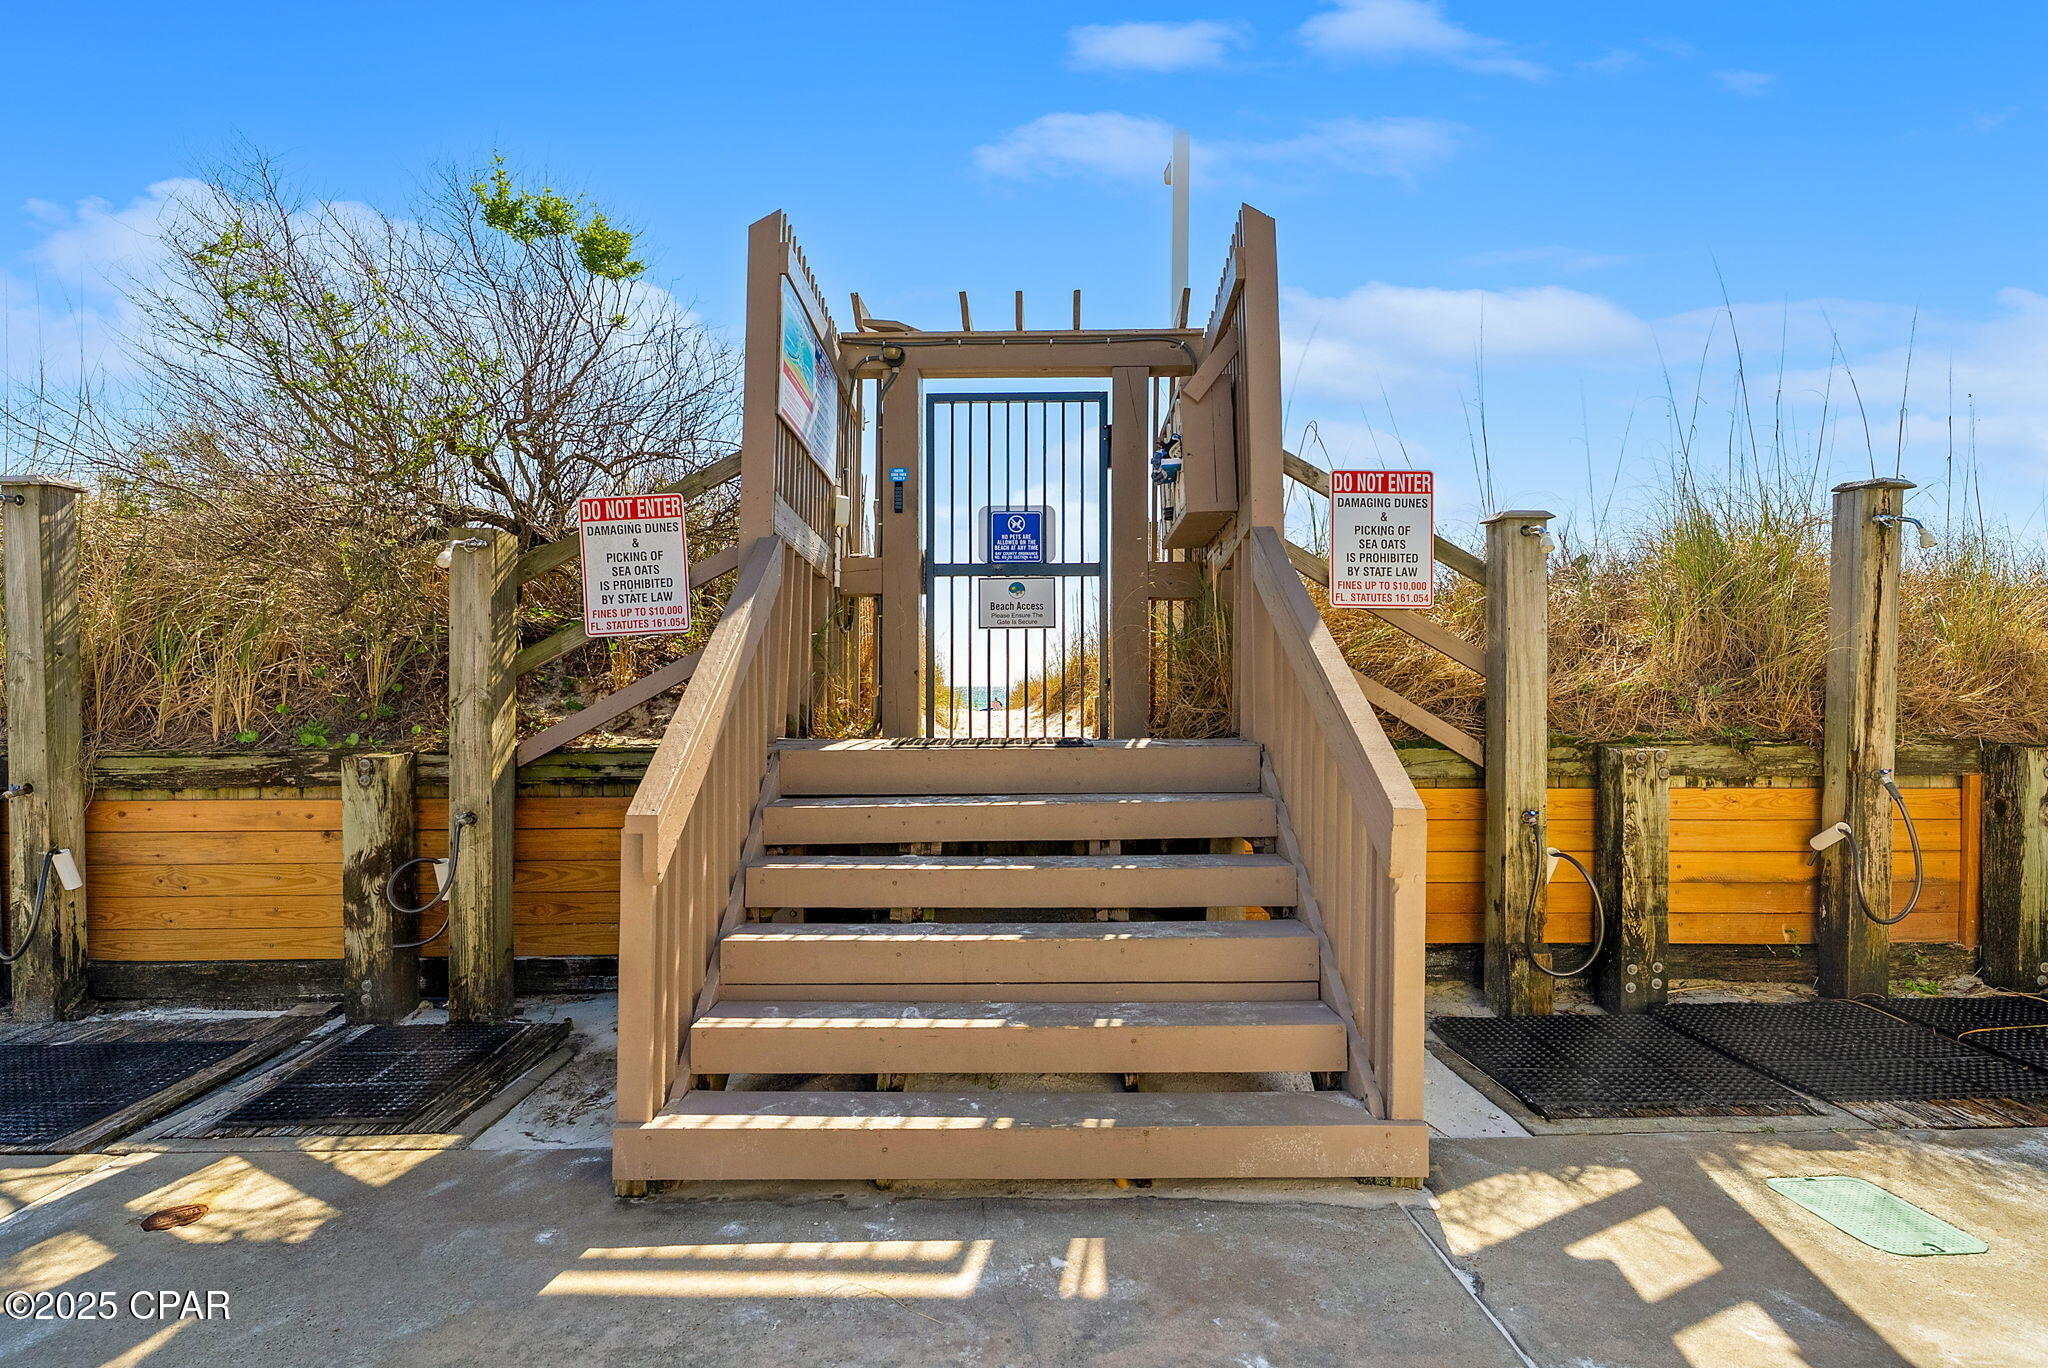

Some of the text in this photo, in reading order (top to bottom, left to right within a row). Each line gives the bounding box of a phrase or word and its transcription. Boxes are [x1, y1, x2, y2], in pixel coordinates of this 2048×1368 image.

[1334, 473, 1431, 492] DO NOT ENTER
[581, 497, 681, 520] DO NOT ENTER
[1338, 498, 1428, 508] DAMAGING DUNES
[1381, 512, 1387, 521] &
[587, 522, 678, 536] DAMAGING DUNES
[1355, 525, 1411, 536] PICKING OF
[632, 538, 639, 548] &
[1359, 539, 1406, 549] SEA OATS
[606, 551, 663, 563] PICKING OF
[1346, 553, 1418, 563] IS PROHIBITED
[612, 565, 660, 576] SEA OATS
[1348, 567, 1418, 576] BY STATE LAW
[600, 578, 673, 590] IS PROHIBITED
[1338, 581, 1427, 591] FINES UP TO $10,000
[602, 592, 673, 604] BY STATE LAW
[1336, 593, 1429, 602] FL. STATUTES 161.054
[991, 602, 1043, 610] Beach Access
[592, 606, 682, 618] FINES UP TO $10,000
[591, 618, 685, 631] FL. STATUTES 161.054
